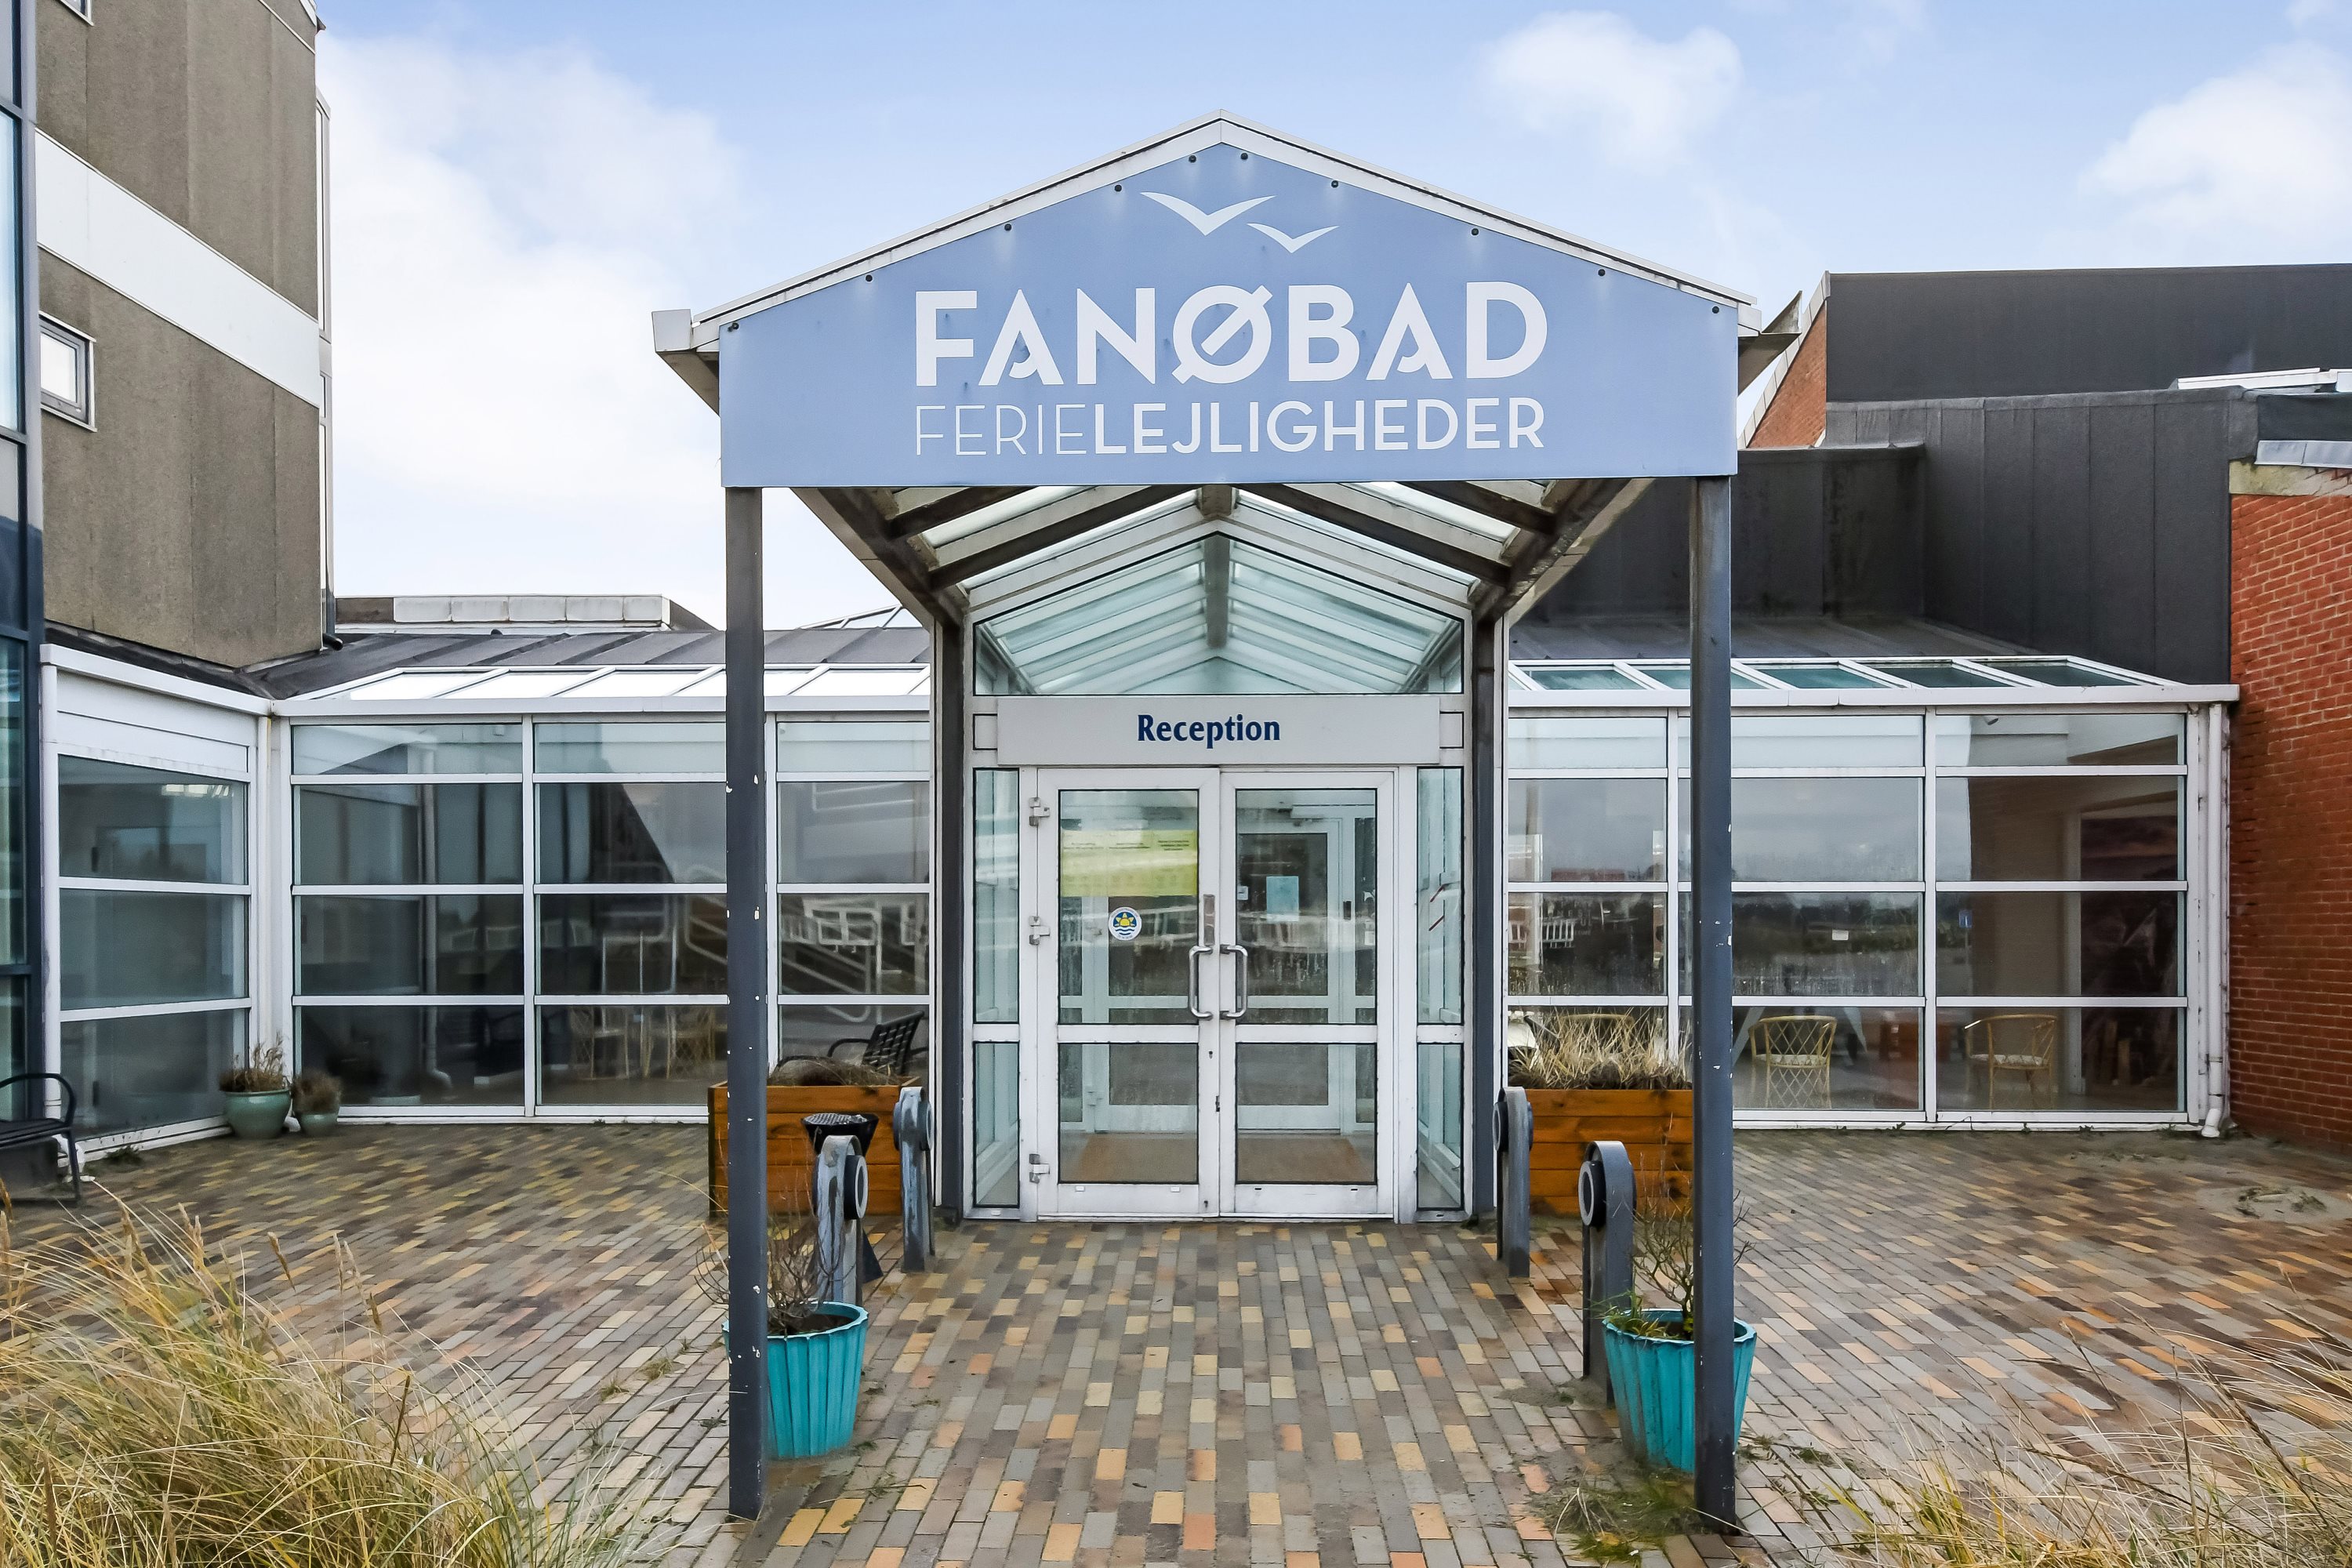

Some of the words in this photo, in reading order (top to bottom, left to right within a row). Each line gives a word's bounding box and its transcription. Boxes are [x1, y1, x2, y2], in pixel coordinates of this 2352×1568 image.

[915, 282, 1548, 387] FANØBAD
[916, 397, 1545, 456] FERIELEJLIGHEDER
[1138, 714, 1280, 750] Reception
